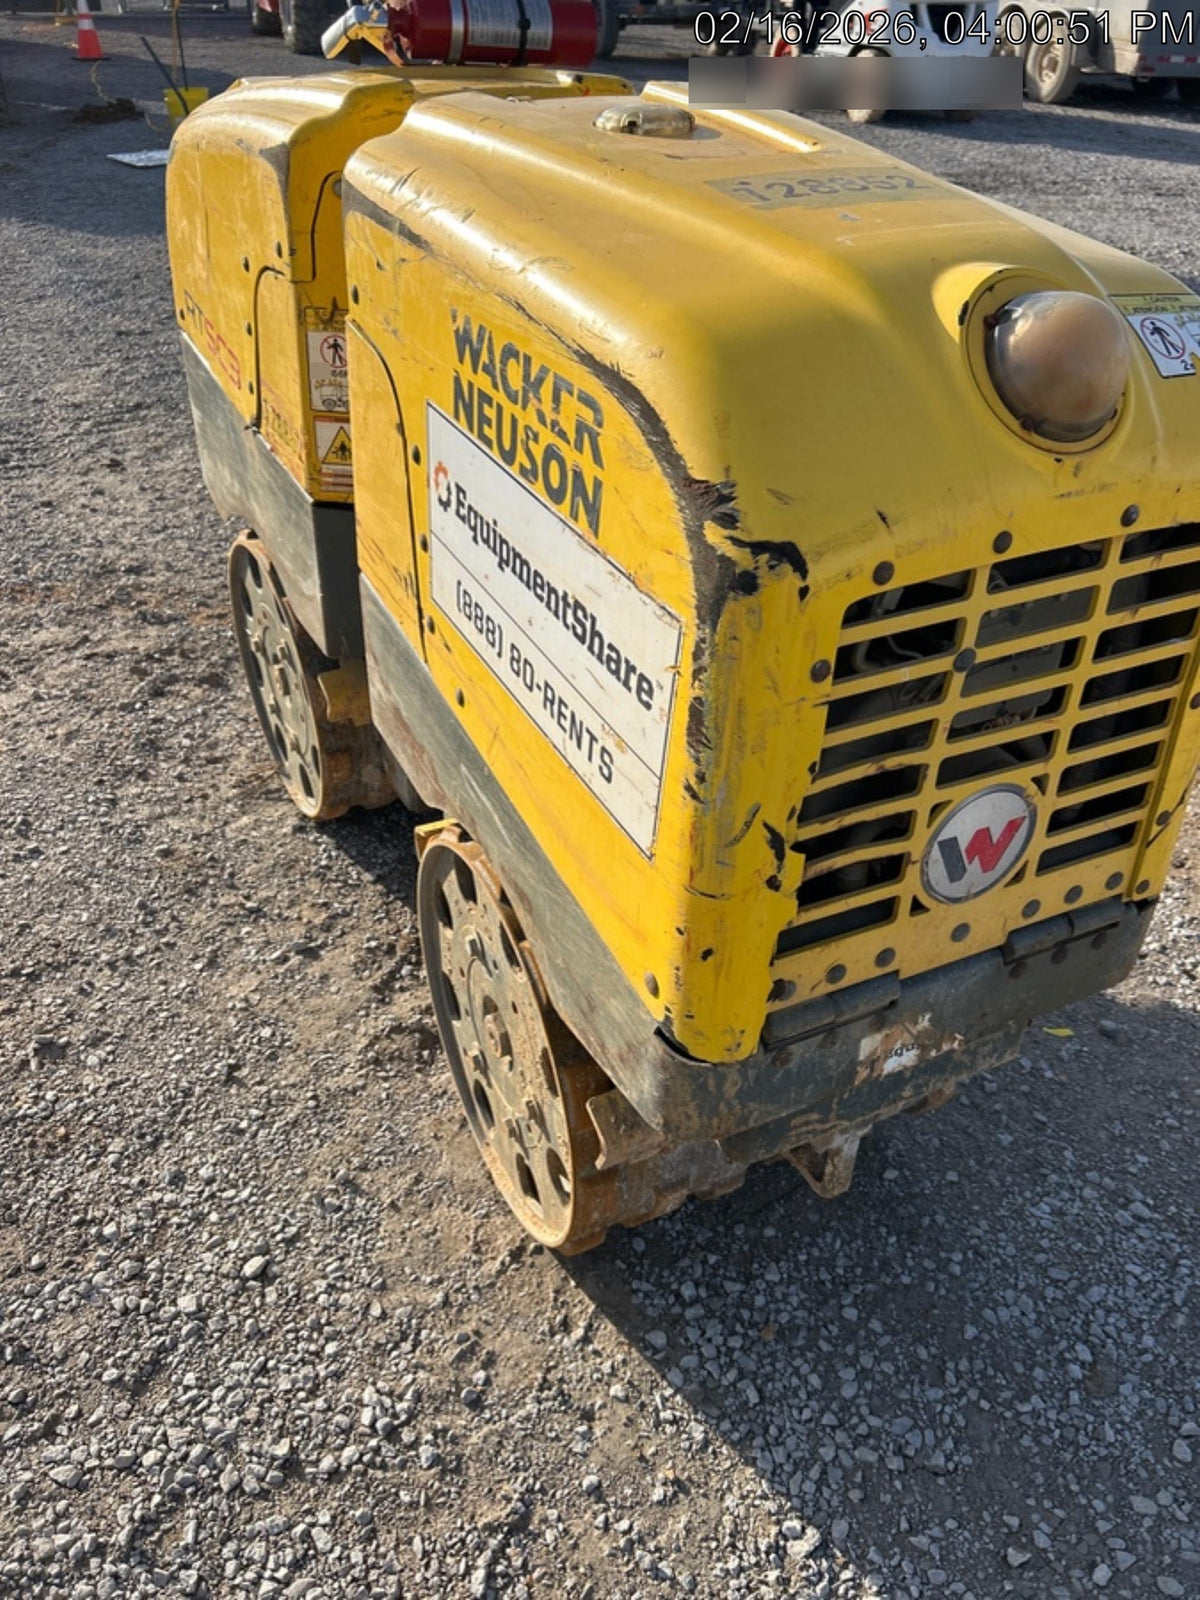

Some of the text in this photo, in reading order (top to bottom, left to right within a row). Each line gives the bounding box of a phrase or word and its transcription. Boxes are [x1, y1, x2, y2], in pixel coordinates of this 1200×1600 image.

[451, 308, 605, 470] WACKER
[453, 370, 603, 541] NEUSON
[454, 482, 655, 711] EquipmentShare
[456, 579, 615, 784] (888) 80-RENTS
